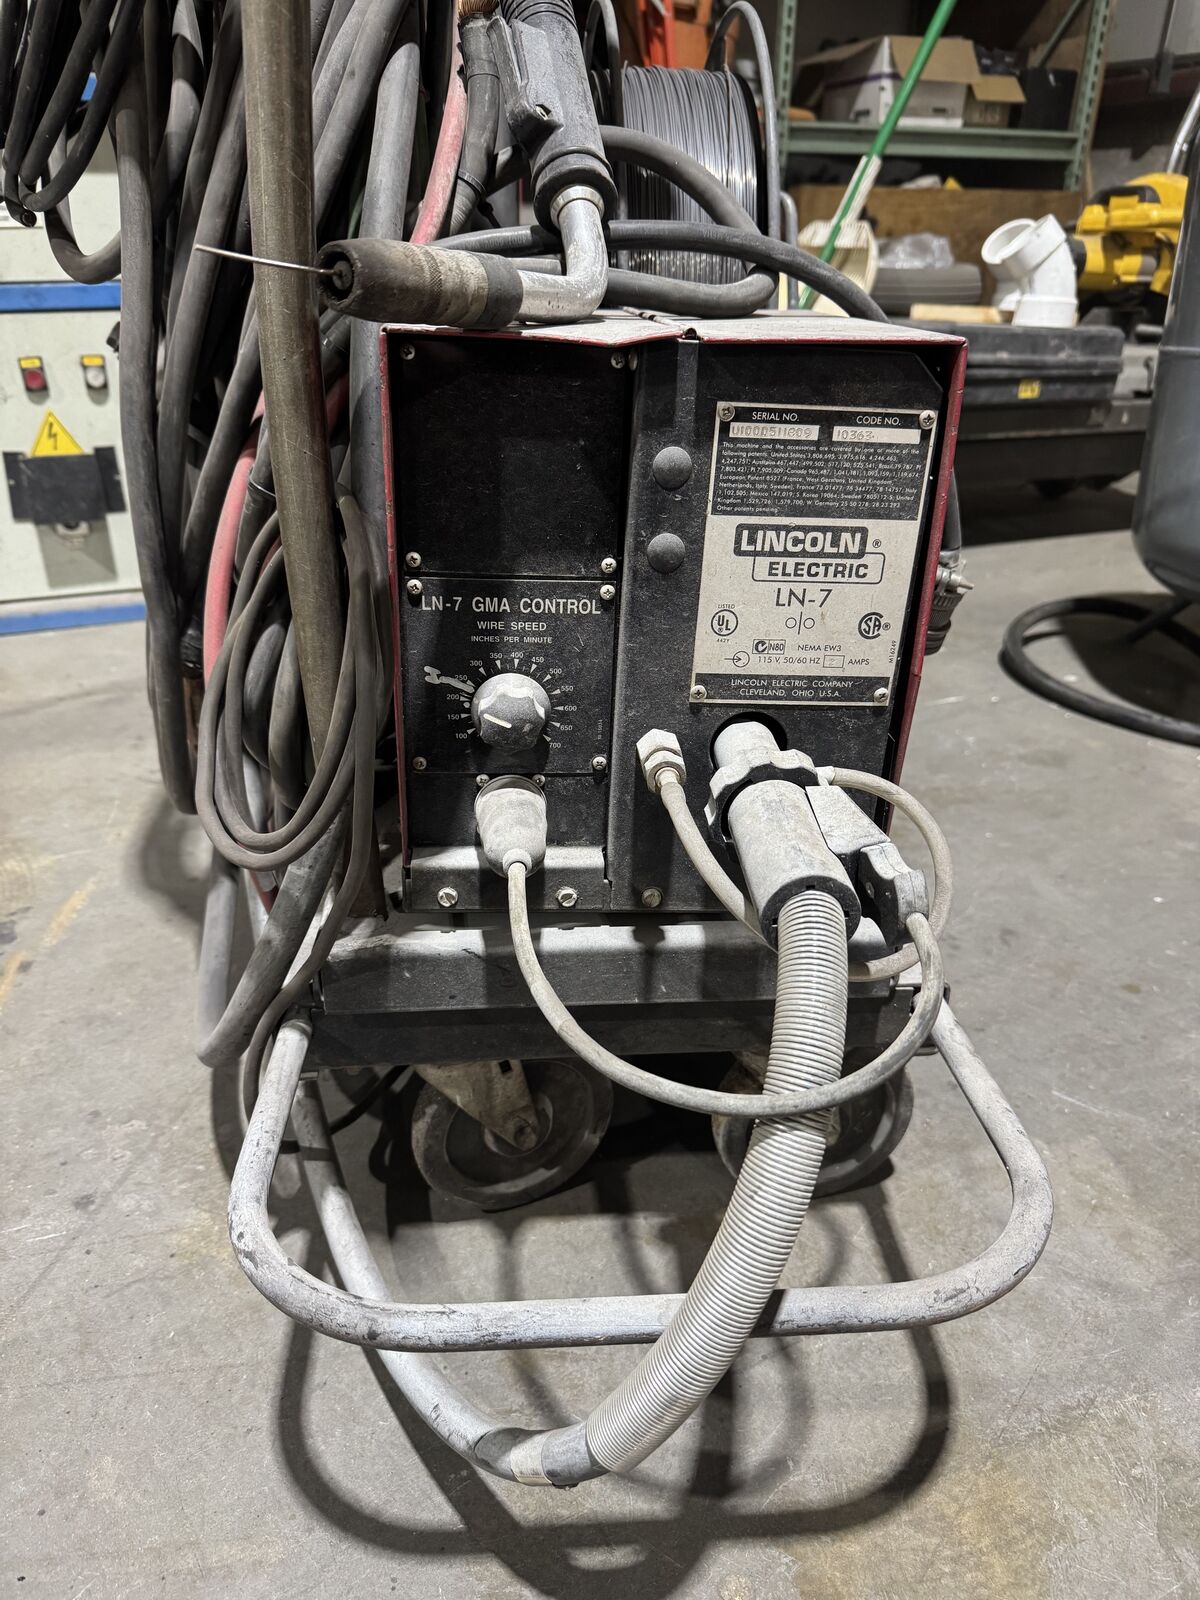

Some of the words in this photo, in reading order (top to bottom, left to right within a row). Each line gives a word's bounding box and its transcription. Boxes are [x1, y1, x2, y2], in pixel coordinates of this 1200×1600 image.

[752, 412, 780, 421] SERIAL
[782, 413, 800, 422] NO.
[856, 416, 882, 424] CODE
[884, 417, 901, 426] NO.
[836, 430, 872, 440] 10363
[740, 530, 861, 553] LINCOLN
[768, 562, 868, 578] ELECTRIC
[776, 588, 833, 608] LN-7
[421, 596, 463, 611] LN-7
[472, 597, 510, 613] GMA
[520, 598, 601, 614] CONTROL
[477, 621, 504, 630] WIRE
[511, 622, 547, 631] SPEED
[740, 688, 786, 697] CLEVELAND,
